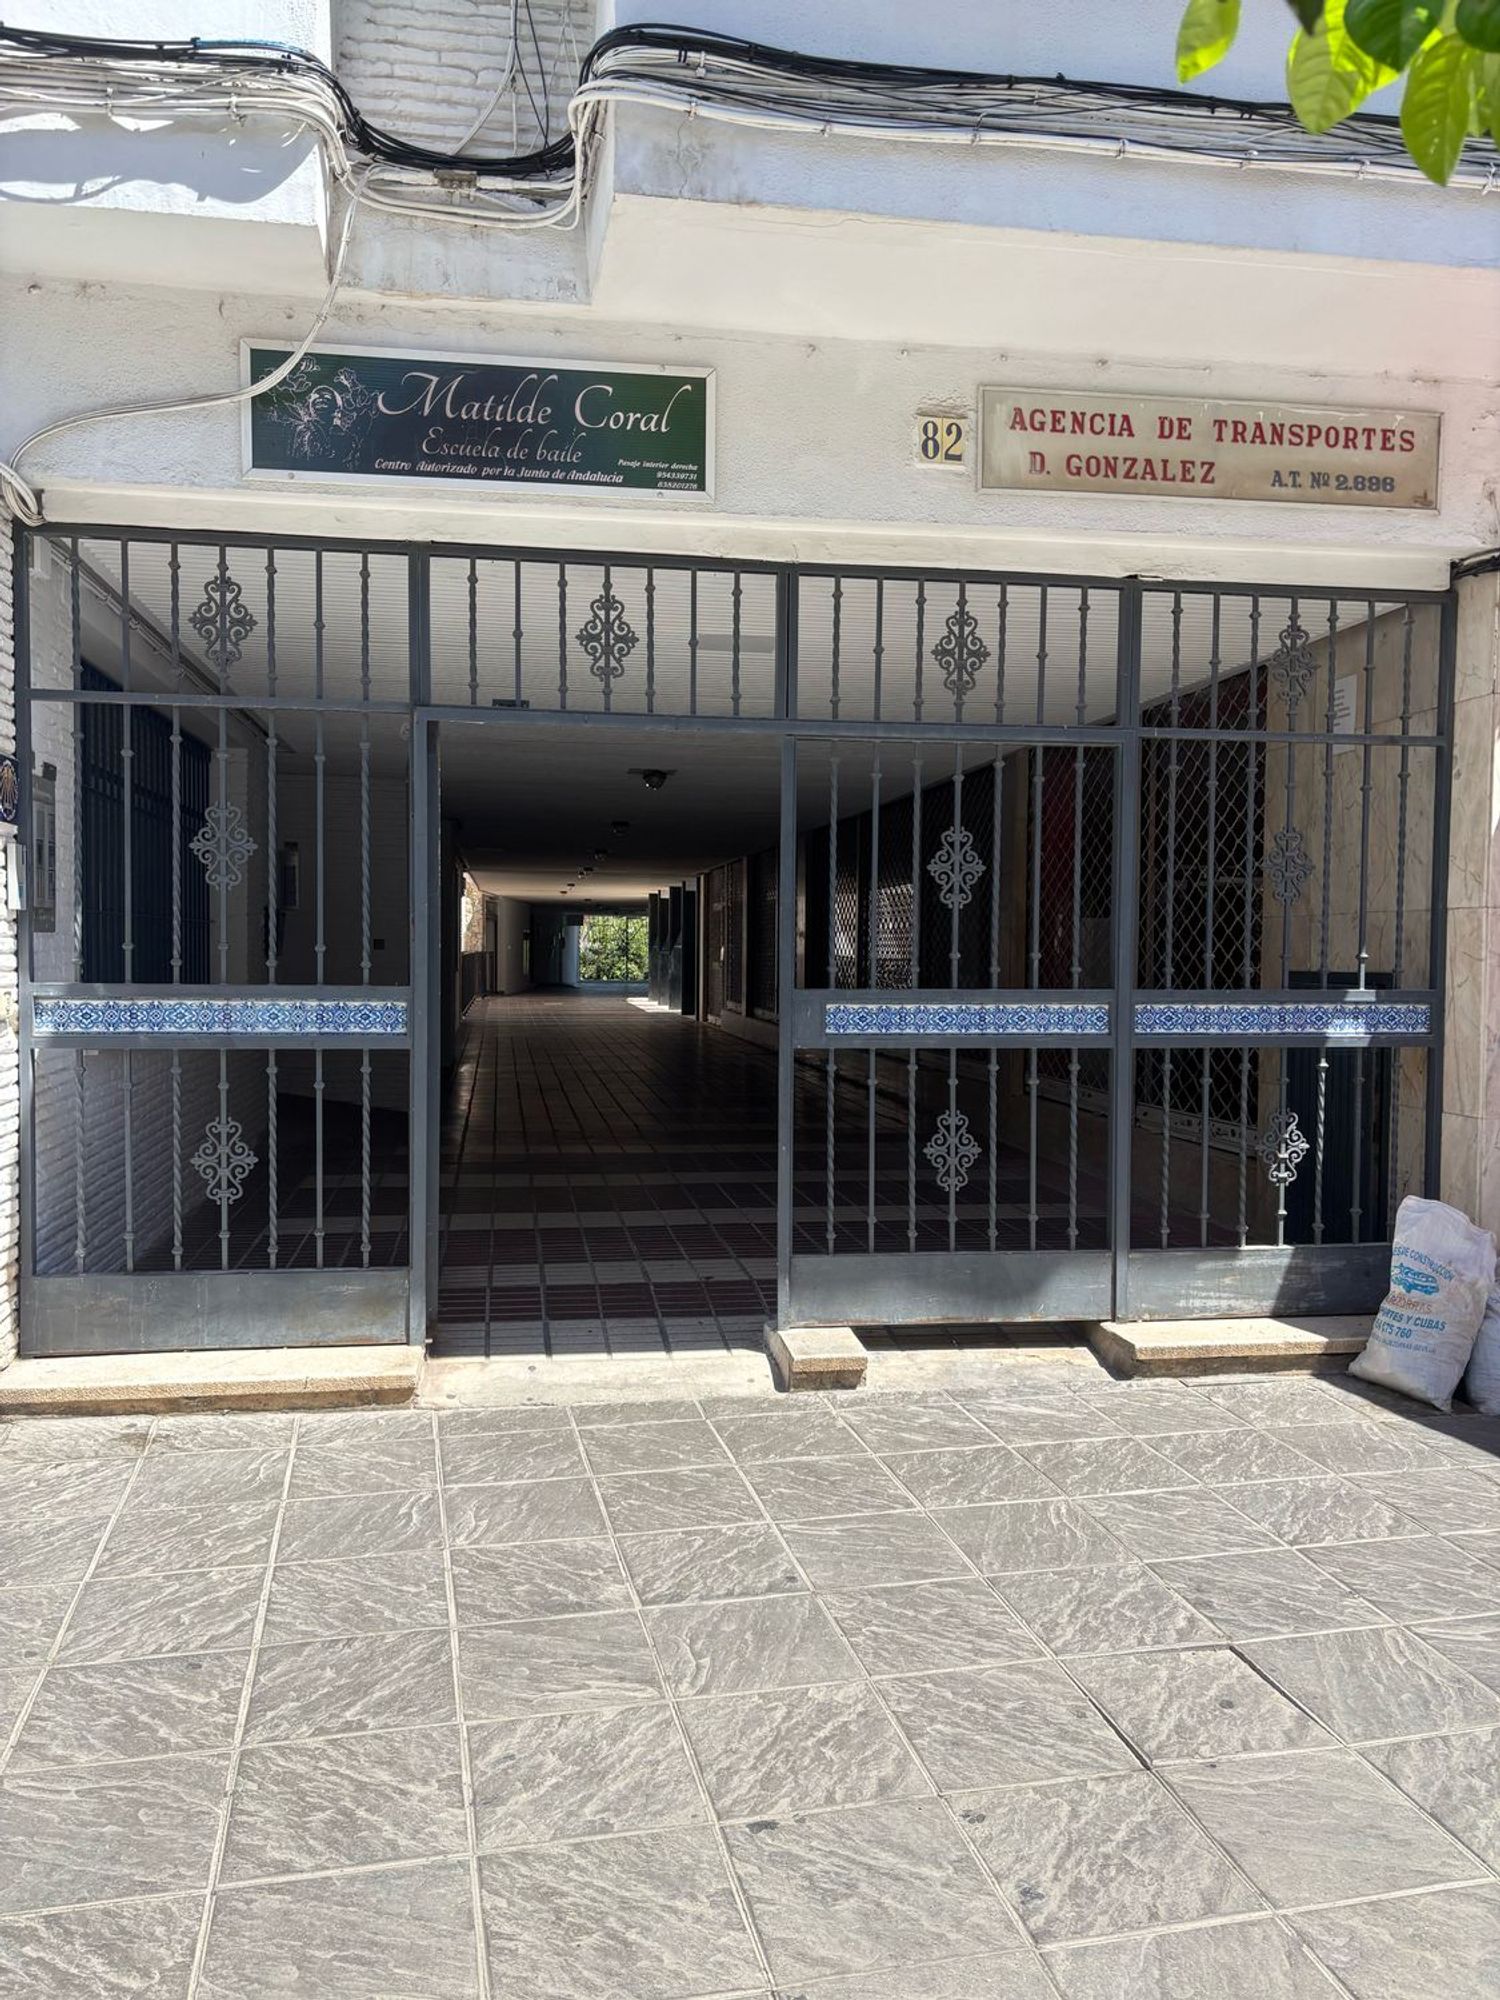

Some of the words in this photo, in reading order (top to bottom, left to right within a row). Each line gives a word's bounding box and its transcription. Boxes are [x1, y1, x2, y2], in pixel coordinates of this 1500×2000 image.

[378, 371, 558, 425] Matilde
[574, 384, 692, 433] Coral
[422, 426, 502, 458] Escuela
[507, 428, 533, 460] de
[536, 429, 587, 463] baile
[921, 420, 963, 461] 82
[1009, 407, 1135, 438] AGENCIA
[1158, 416, 1192, 440] DE
[1213, 419, 1415, 452] TRANSPORTES
[375, 458, 412, 471] Centro
[416, 459, 478, 474] Autorizado
[482, 464, 502, 477] por
[504, 465, 515, 476] la
[517, 466, 550, 479] Junta
[552, 468, 565, 480] de
[618, 459, 640, 468] Pasaje
[642, 461, 669, 469] interior
[671, 462, 698, 471] derecha
[1029, 451, 1051, 475] D.
[1065, 454, 1216, 484] GONZALEZ
[1271, 470, 1302, 488] A.T.
[1406, 1315, 1413, 1324] Y
[1414, 1316, 1447, 1332] CUBAS
